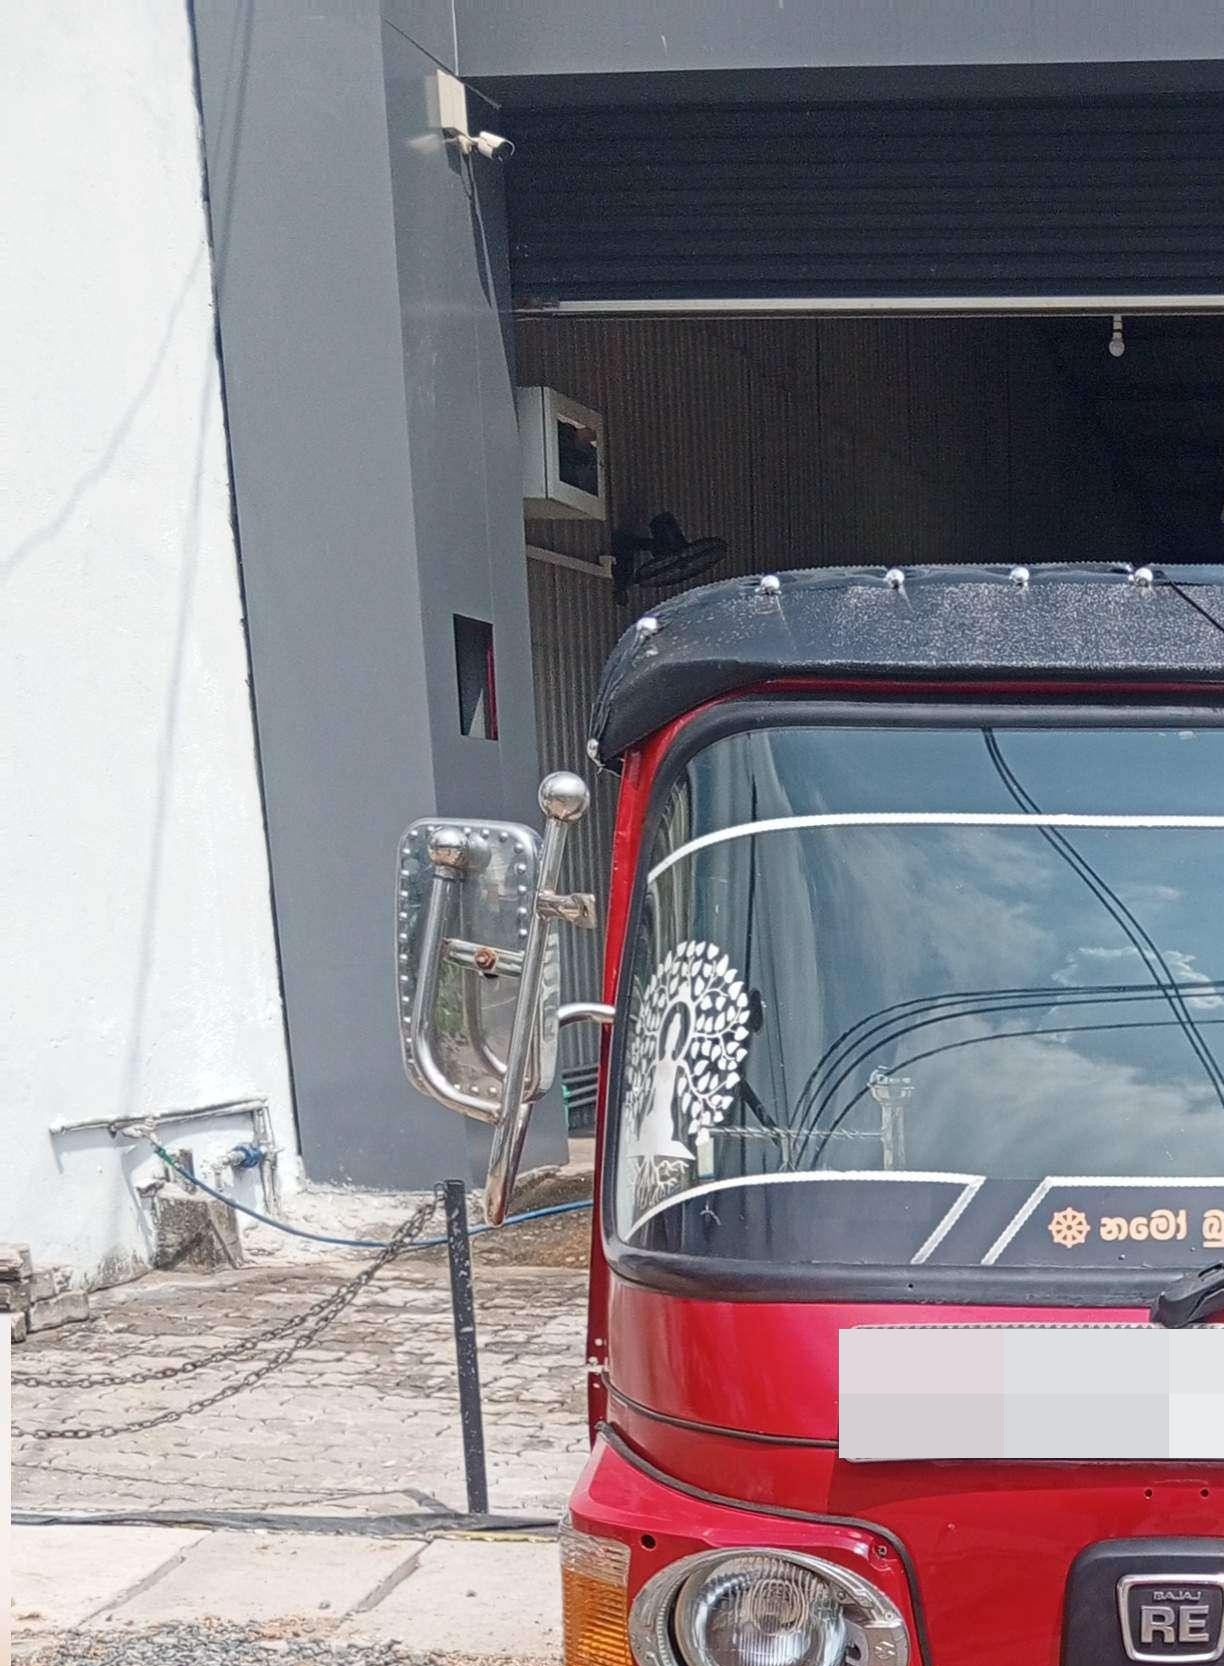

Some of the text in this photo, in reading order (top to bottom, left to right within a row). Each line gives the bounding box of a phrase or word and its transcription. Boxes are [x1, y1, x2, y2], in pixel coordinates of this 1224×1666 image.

[1100, 1208, 1187, 1241] නමෝ
[1153, 1590, 1201, 1600] BAJAJ
[1140, 1604, 1210, 1643] RE
